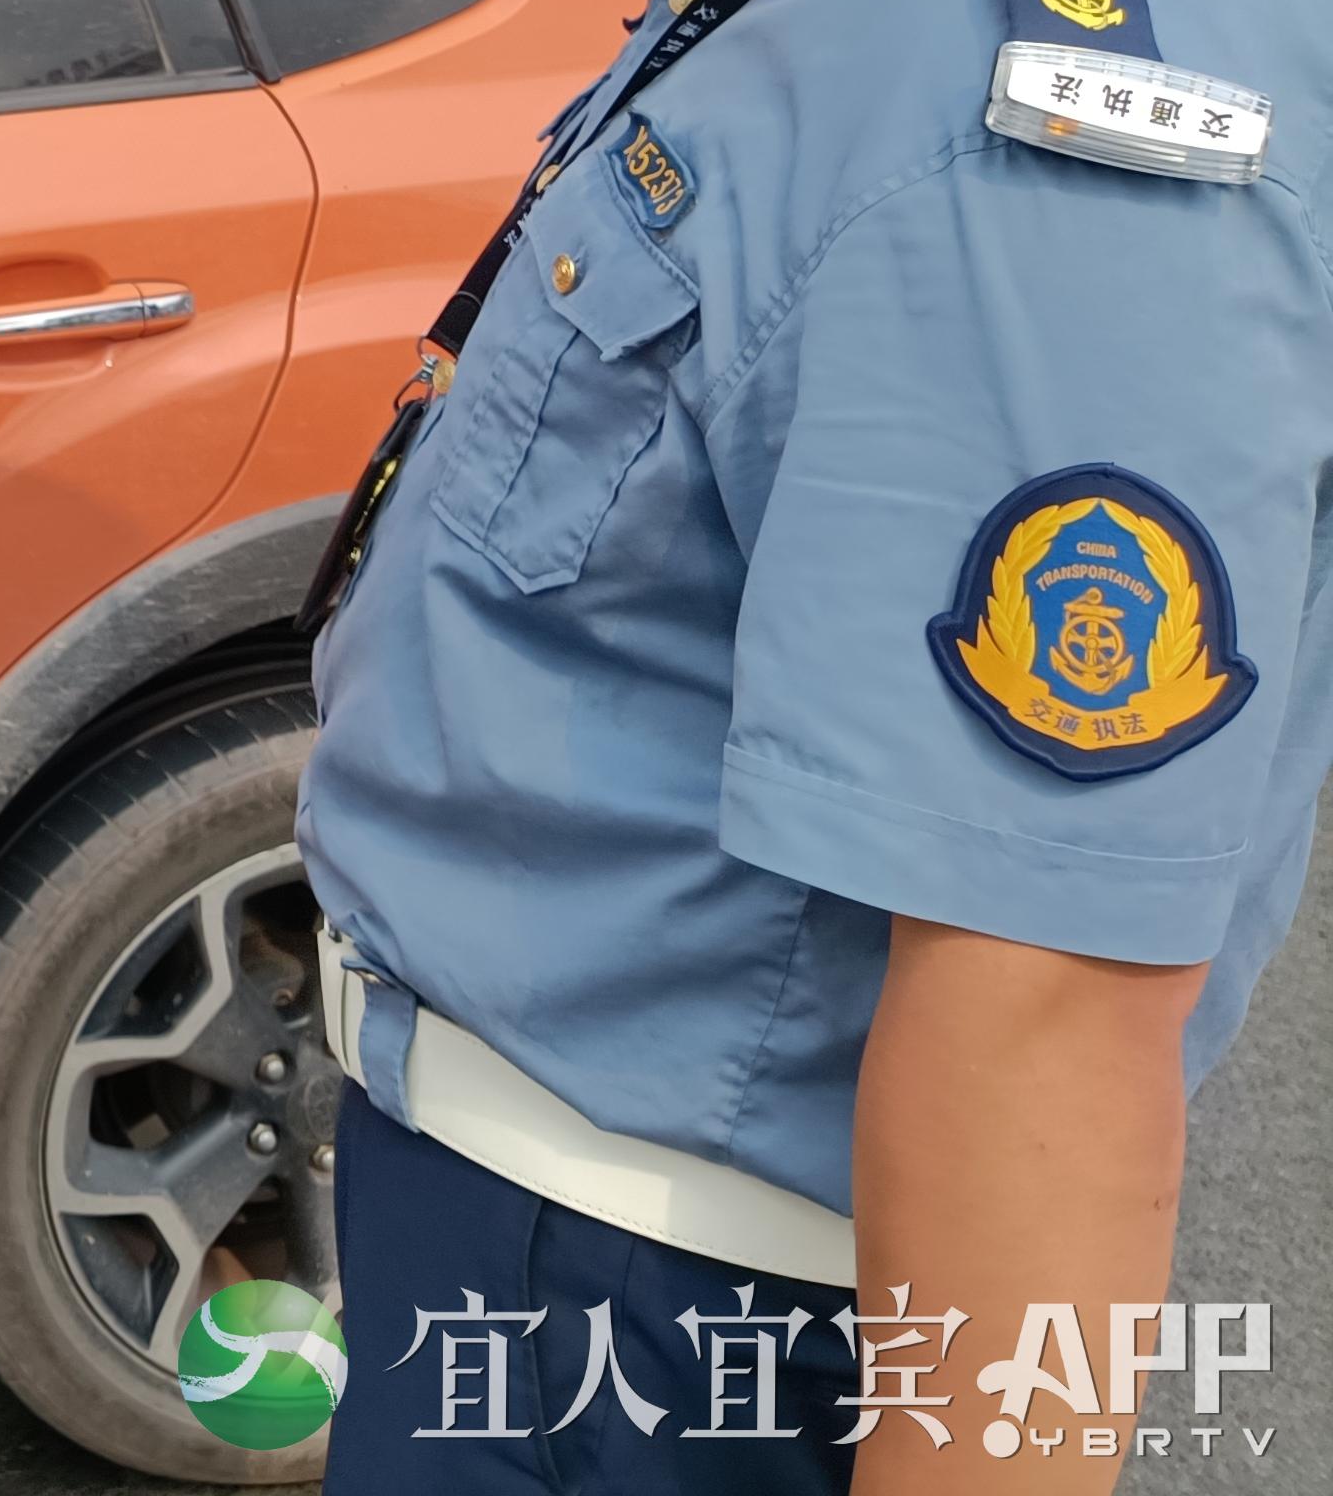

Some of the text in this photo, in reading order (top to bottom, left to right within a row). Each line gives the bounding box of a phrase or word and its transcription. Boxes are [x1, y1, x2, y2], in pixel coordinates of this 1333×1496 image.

[1049, 72, 1234, 141] 交通执法
[1076, 541, 1117, 558] CHINA
[1035, 563, 1155, 605] TRANSPORTATION
[1023, 696, 1150, 741] 交通执法
